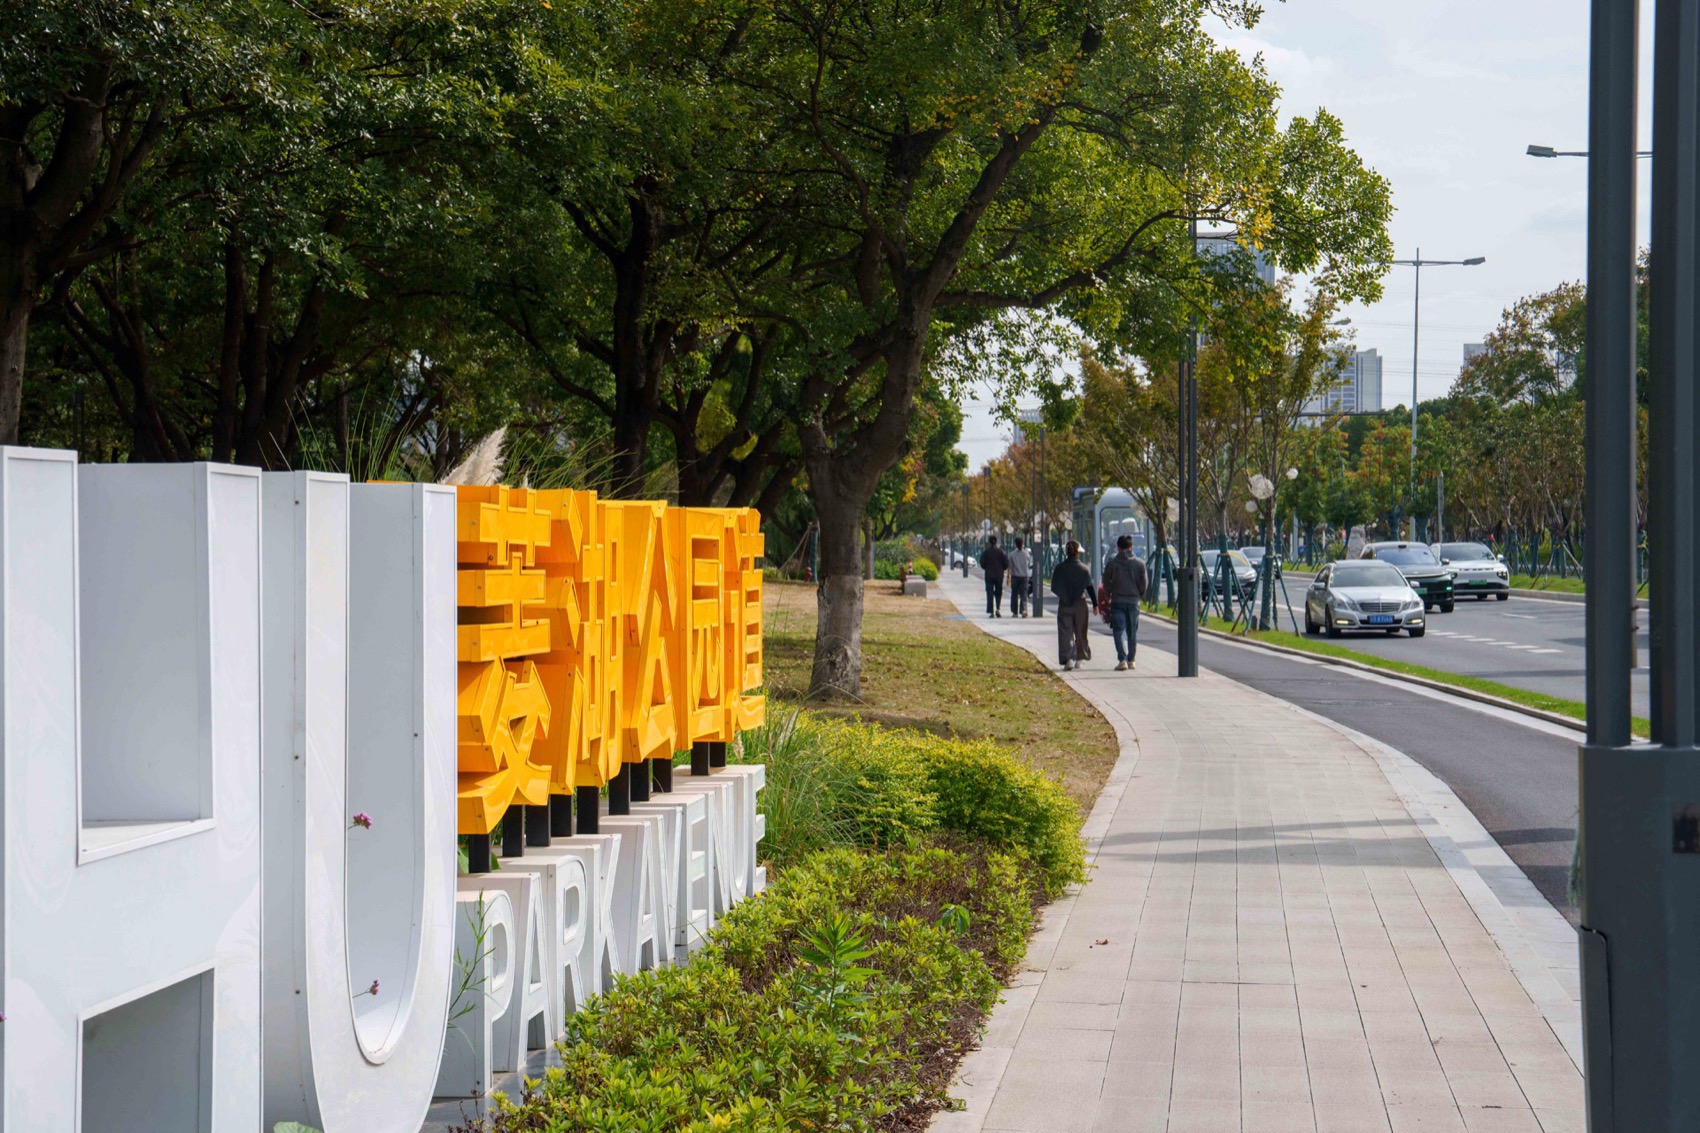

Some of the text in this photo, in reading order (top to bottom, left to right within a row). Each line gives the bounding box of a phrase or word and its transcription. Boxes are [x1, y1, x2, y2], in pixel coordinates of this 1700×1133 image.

[457, 484, 765, 835] 菱湖公园道
[468, 764, 766, 1092] PARK AVENUE
